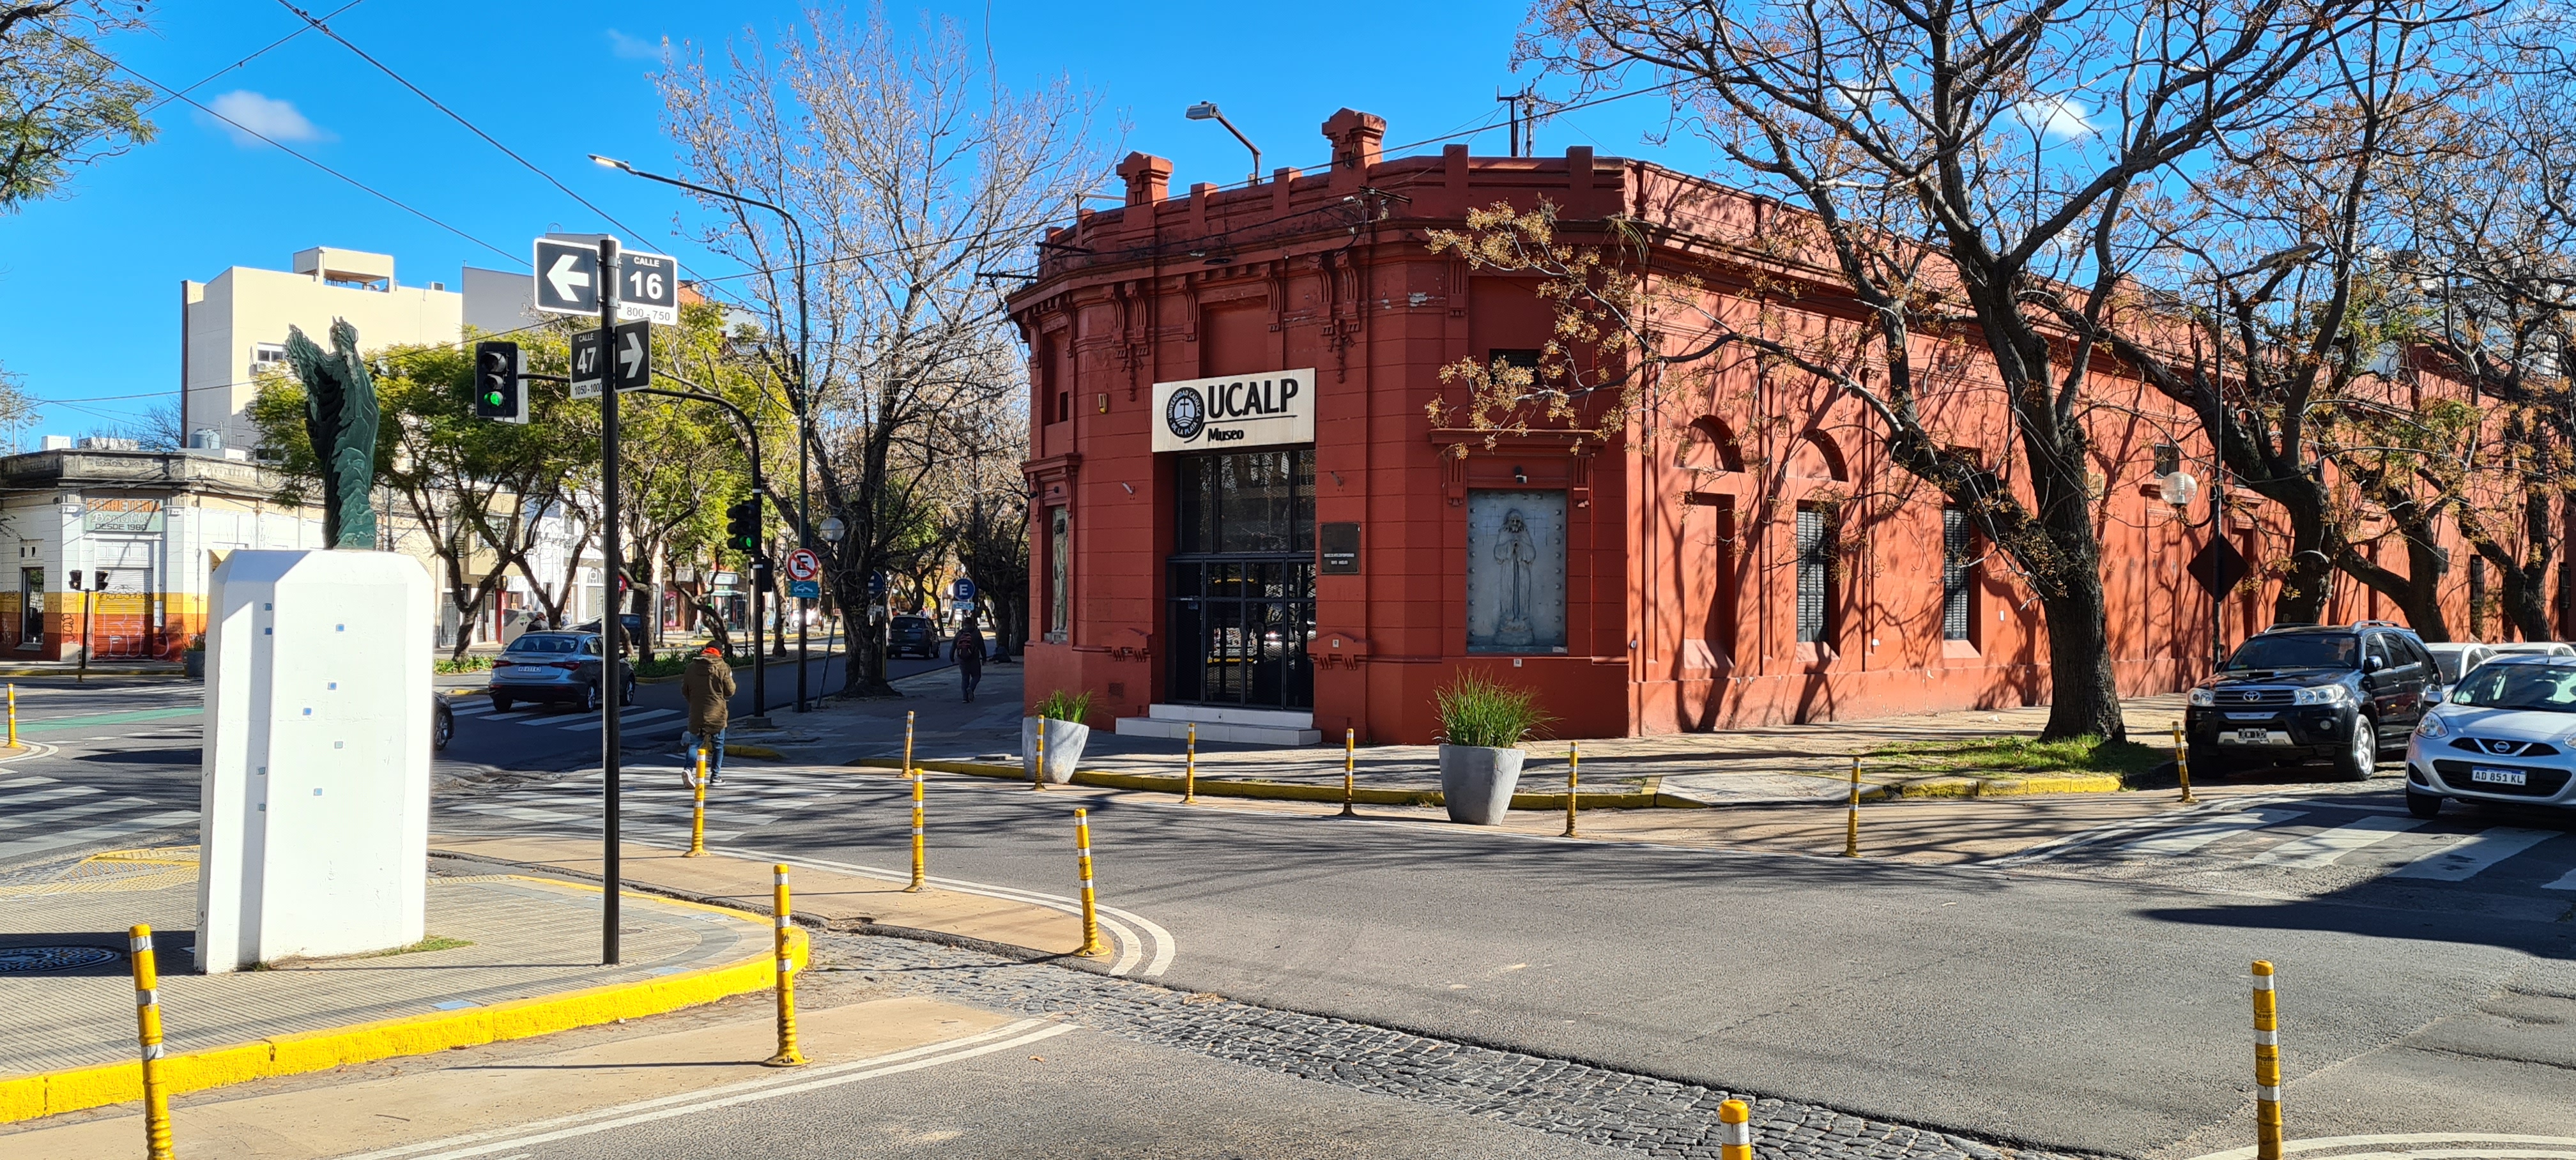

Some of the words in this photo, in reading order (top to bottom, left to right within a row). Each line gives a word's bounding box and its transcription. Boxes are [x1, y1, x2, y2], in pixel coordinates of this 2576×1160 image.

[634, 257, 659, 268] CALLE
[630, 271, 663, 300] 16
[627, 307, 644, 317] 800
[653, 310, 670, 321] 750
[578, 333, 594, 342] CALLE
[577, 347, 597, 374] 47
[1168, 390, 1189, 418] UNIVERSIDAD
[1208, 378, 1298, 418] UCALP
[1171, 423, 1178, 432] DE
[1184, 422, 1198, 435] PLATA
[1208, 428, 1244, 441] Museo
[87, 499, 161, 512] FERRETERIA
[797, 555, 809, 570] E
[959, 584, 968, 596] E
[2475, 772, 2487, 781] AD
[2490, 772, 2508, 782] 851
[2511, 774, 2523, 784] KL
